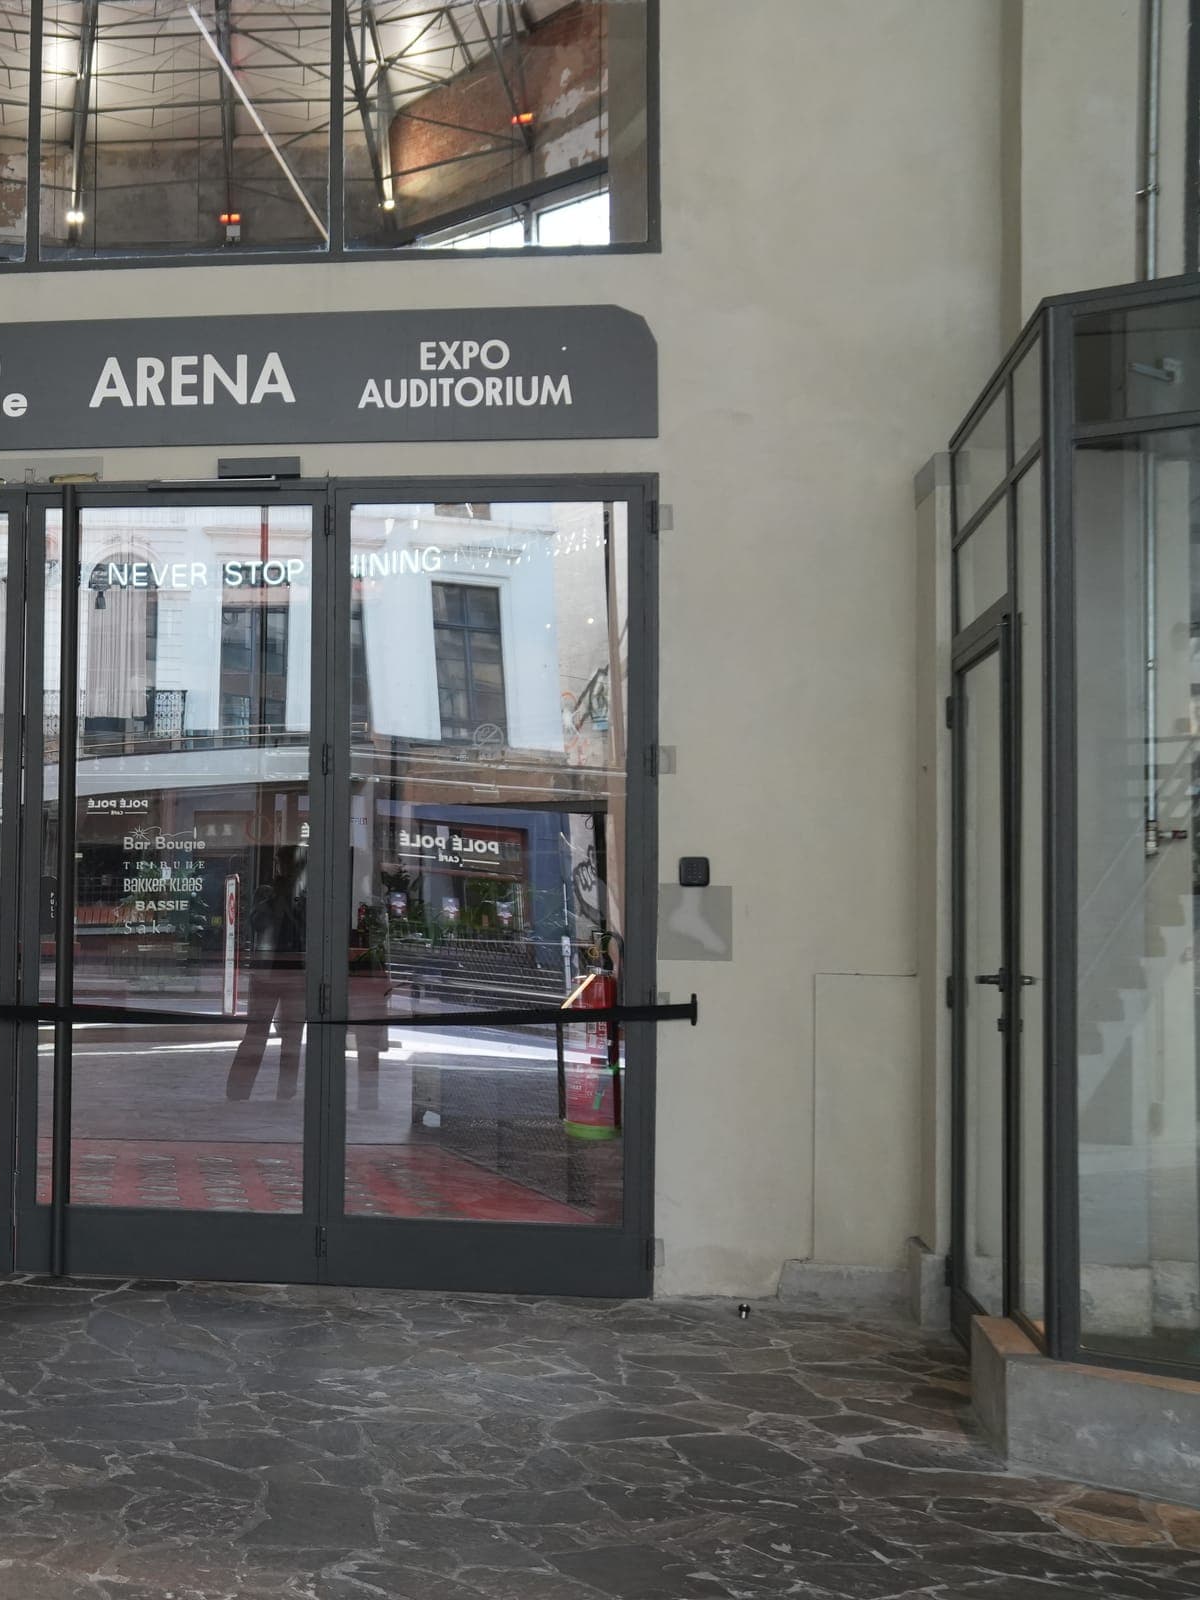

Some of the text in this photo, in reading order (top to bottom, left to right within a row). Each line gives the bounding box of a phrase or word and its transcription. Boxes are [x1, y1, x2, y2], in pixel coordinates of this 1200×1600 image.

[419, 339, 510, 371] EXPO
[88, 351, 297, 408] ARENA
[357, 374, 573, 409] AUDITORIUM
[108, 561, 208, 588] NEVER
[224, 558, 305, 586] STOP
[123, 836, 206, 853] Bar Bougie
[135, 900, 189, 911] BASSIE
